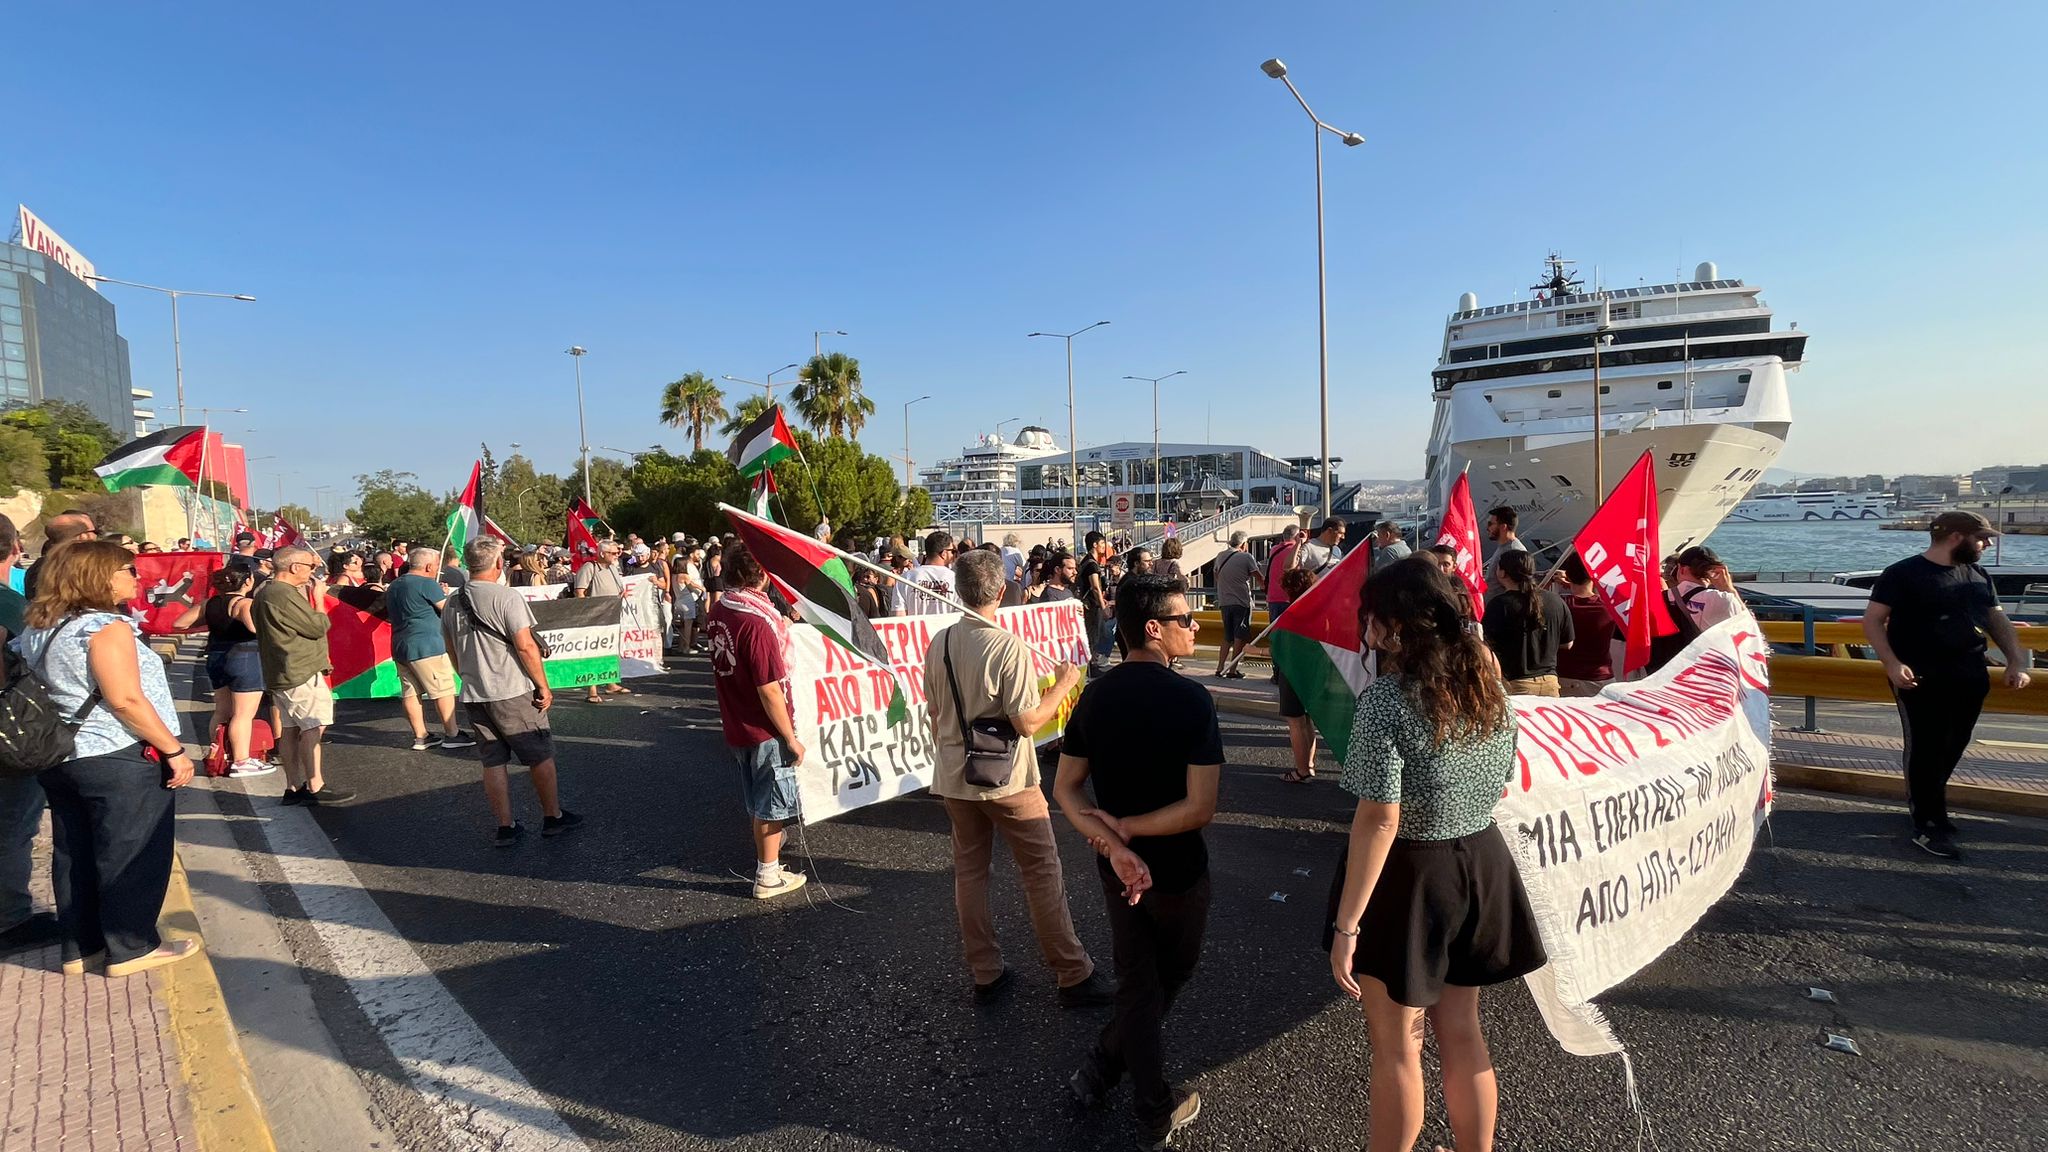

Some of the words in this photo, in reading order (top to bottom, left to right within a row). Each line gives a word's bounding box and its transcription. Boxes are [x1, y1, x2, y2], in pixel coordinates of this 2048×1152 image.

[23, 211, 71, 271] VANOS
[551, 633, 615, 653] enocide!
[815, 675, 862, 725] ΑΠΟ
[1576, 874, 1629, 934] ΑΠΟ
